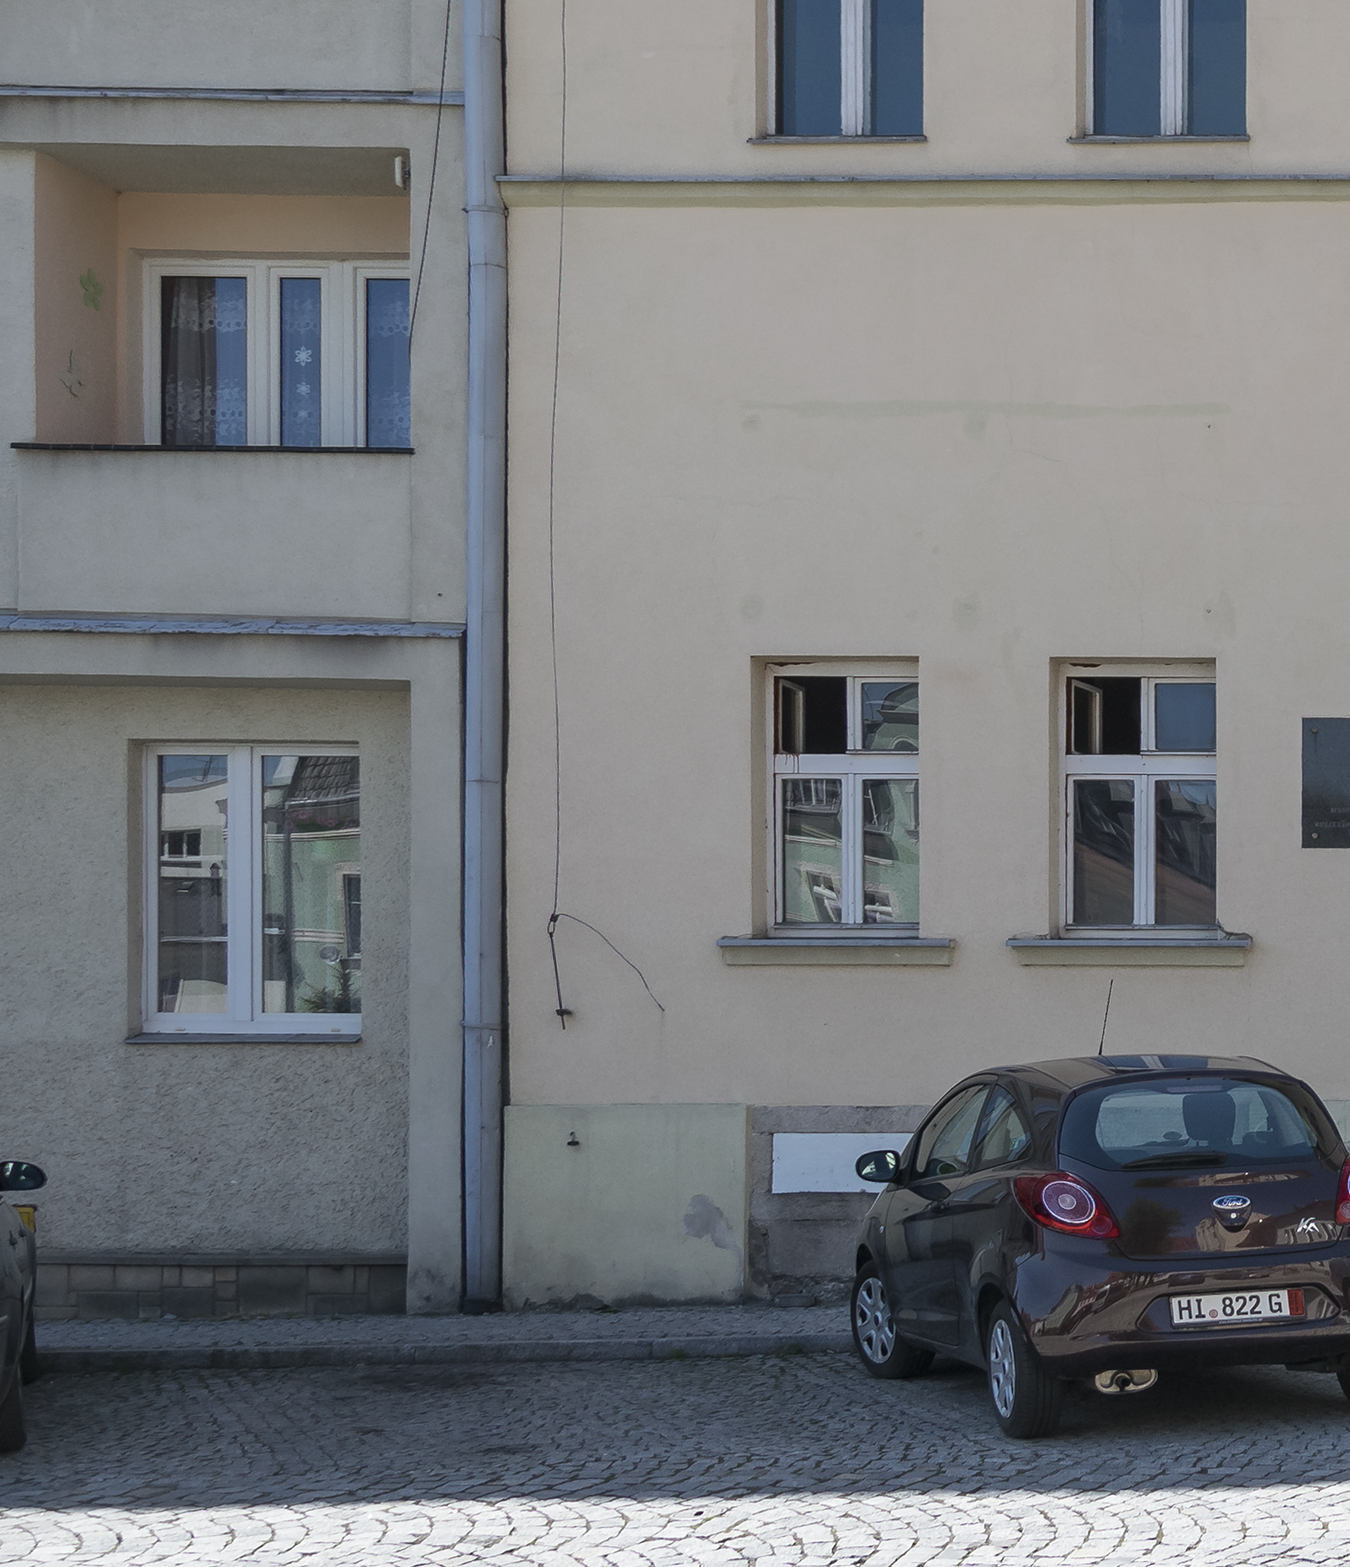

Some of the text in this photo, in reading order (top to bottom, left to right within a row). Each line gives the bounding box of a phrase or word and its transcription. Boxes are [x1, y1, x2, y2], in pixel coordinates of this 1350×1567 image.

[1221, 1197, 1244, 1207] Ford
[1178, 1297, 1206, 1320] HI
[1221, 1294, 1262, 1317] 822
[1268, 1292, 1283, 1314] G
